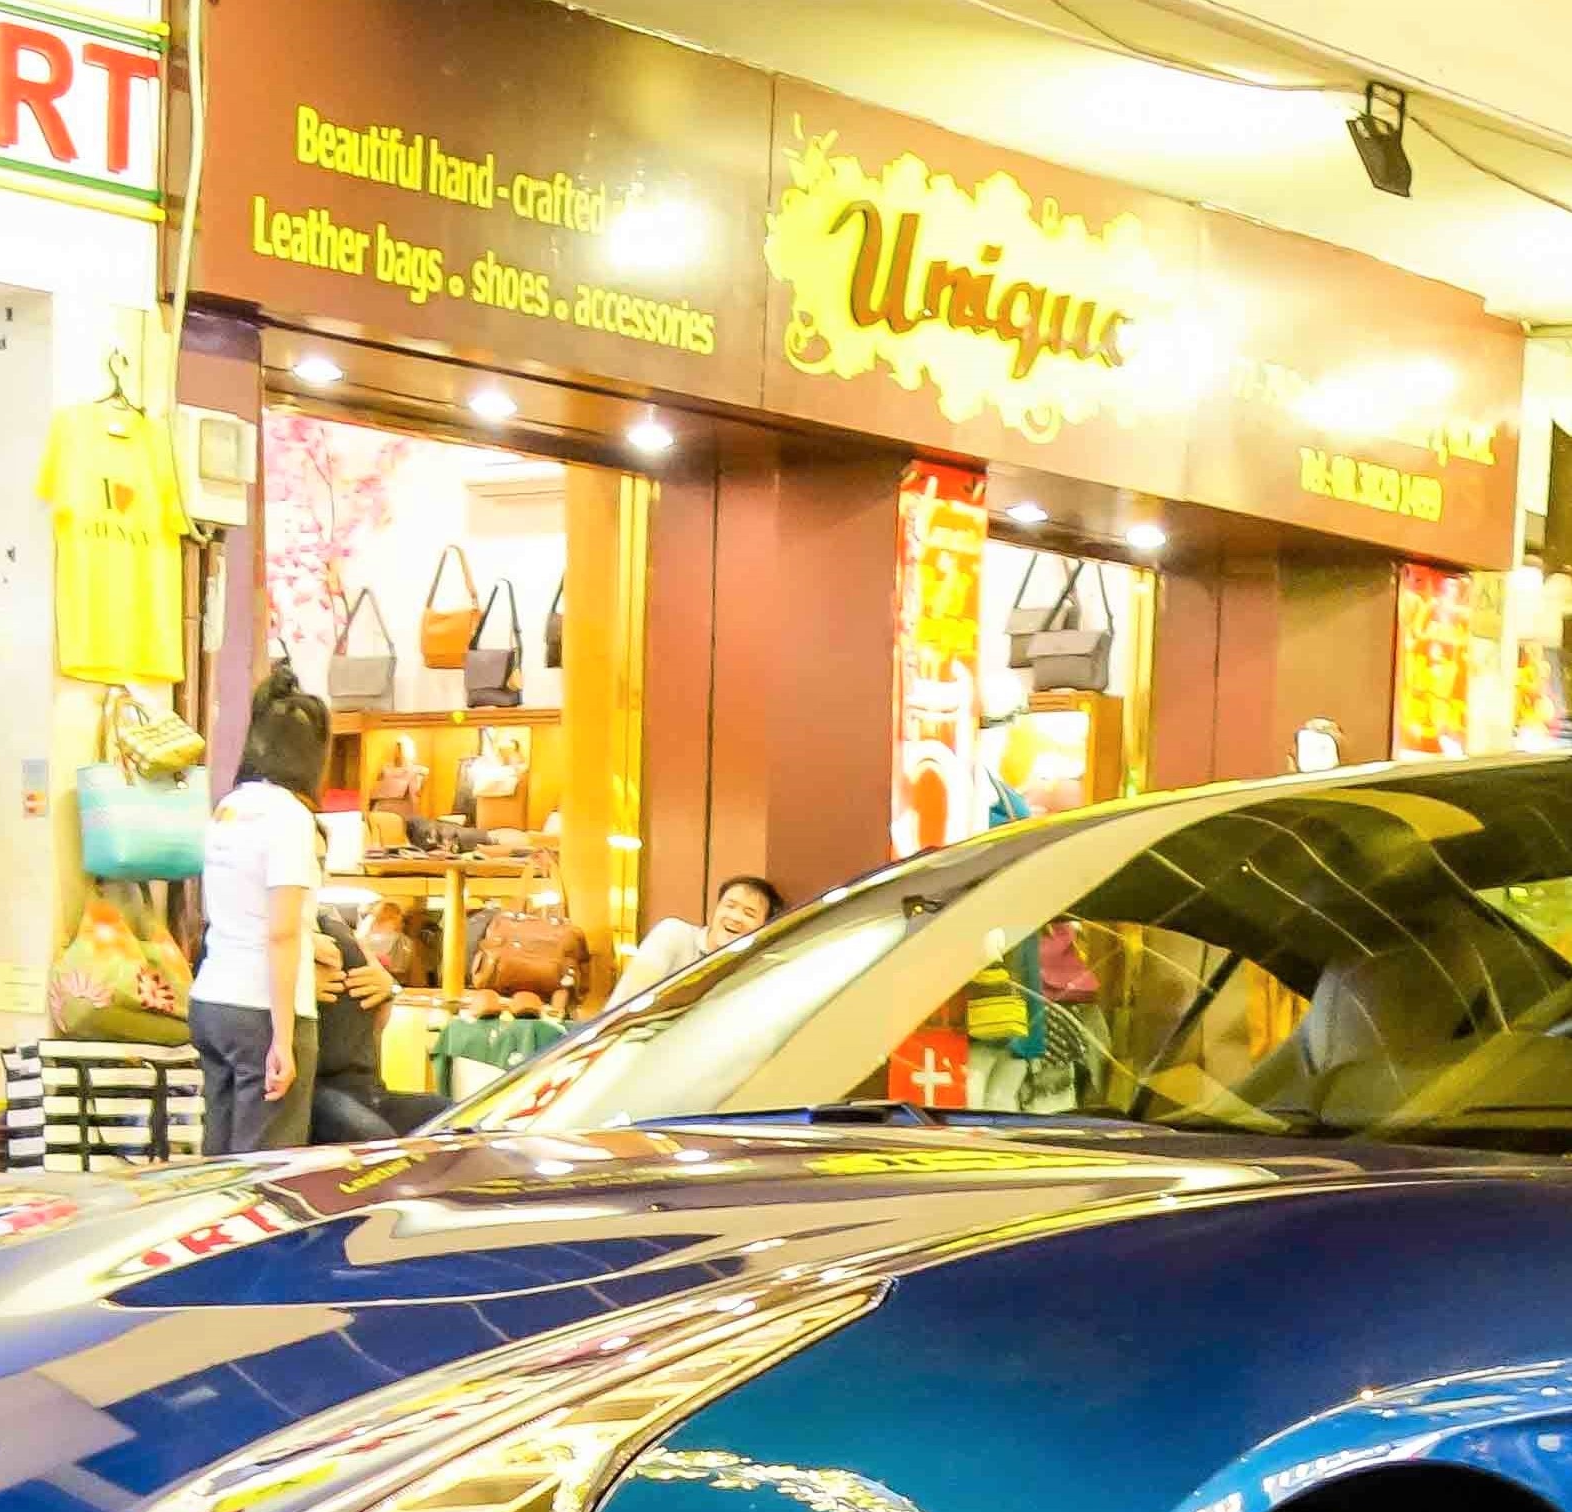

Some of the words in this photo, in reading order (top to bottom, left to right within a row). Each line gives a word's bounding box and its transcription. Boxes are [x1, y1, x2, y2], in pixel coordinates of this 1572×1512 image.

[296, 104, 423, 192] Beautiful
[251, 195, 371, 276] Leather
[375, 222, 445, 305] bags
[471, 250, 551, 319] shoes
[572, 282, 716, 356] accessories
